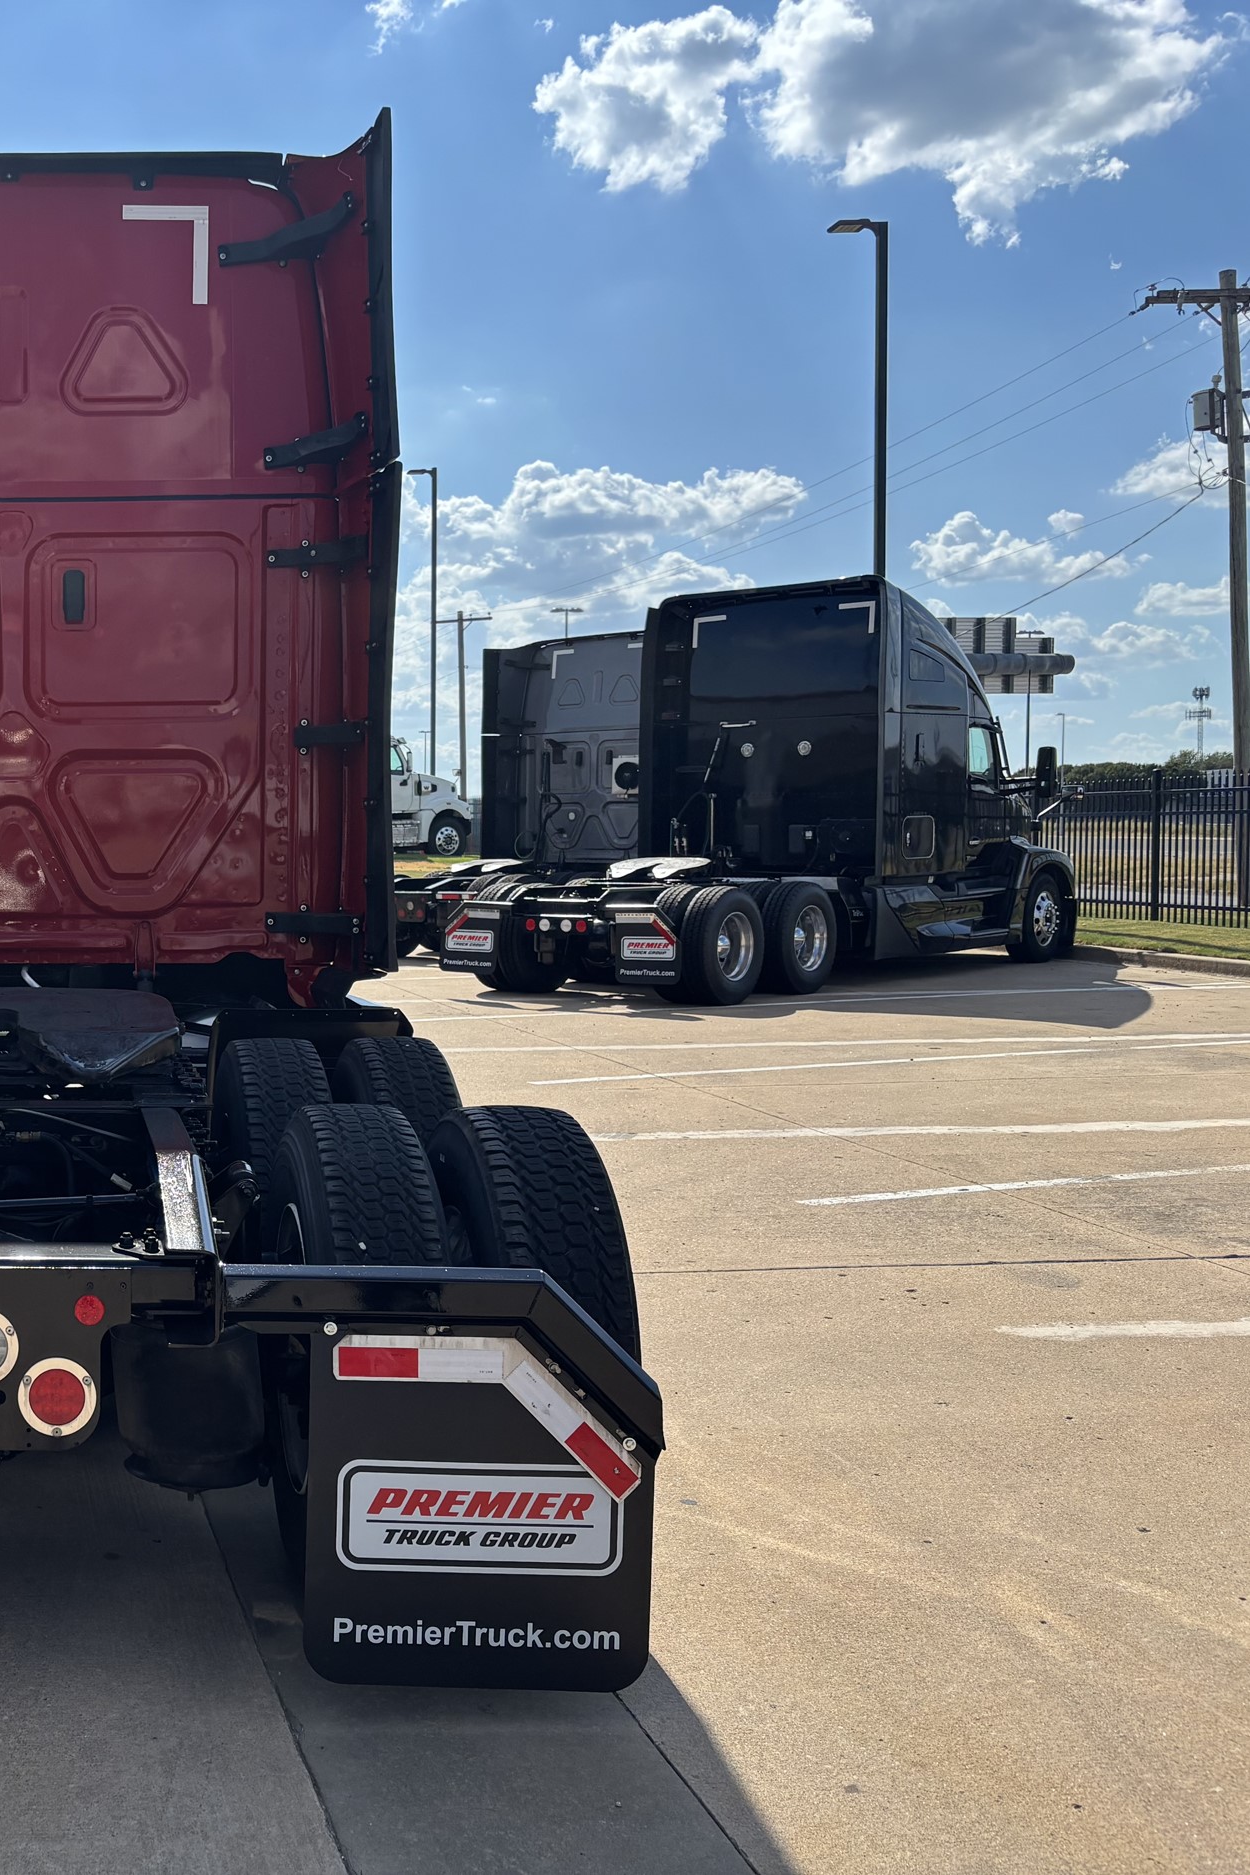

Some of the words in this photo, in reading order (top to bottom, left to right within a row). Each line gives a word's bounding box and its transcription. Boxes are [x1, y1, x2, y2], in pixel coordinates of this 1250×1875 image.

[451, 934, 489, 942] PREMIER
[627, 941, 670, 949] PREMIER
[443, 958, 492, 967] PremierTruck.com
[619, 968, 676, 977] PremierTruck.com
[366, 1487, 595, 1521] PREMIER
[382, 1528, 478, 1547] TRUCK
[479, 1531, 577, 1549] GROUP
[333, 1617, 620, 1650] PremierTruck.com
